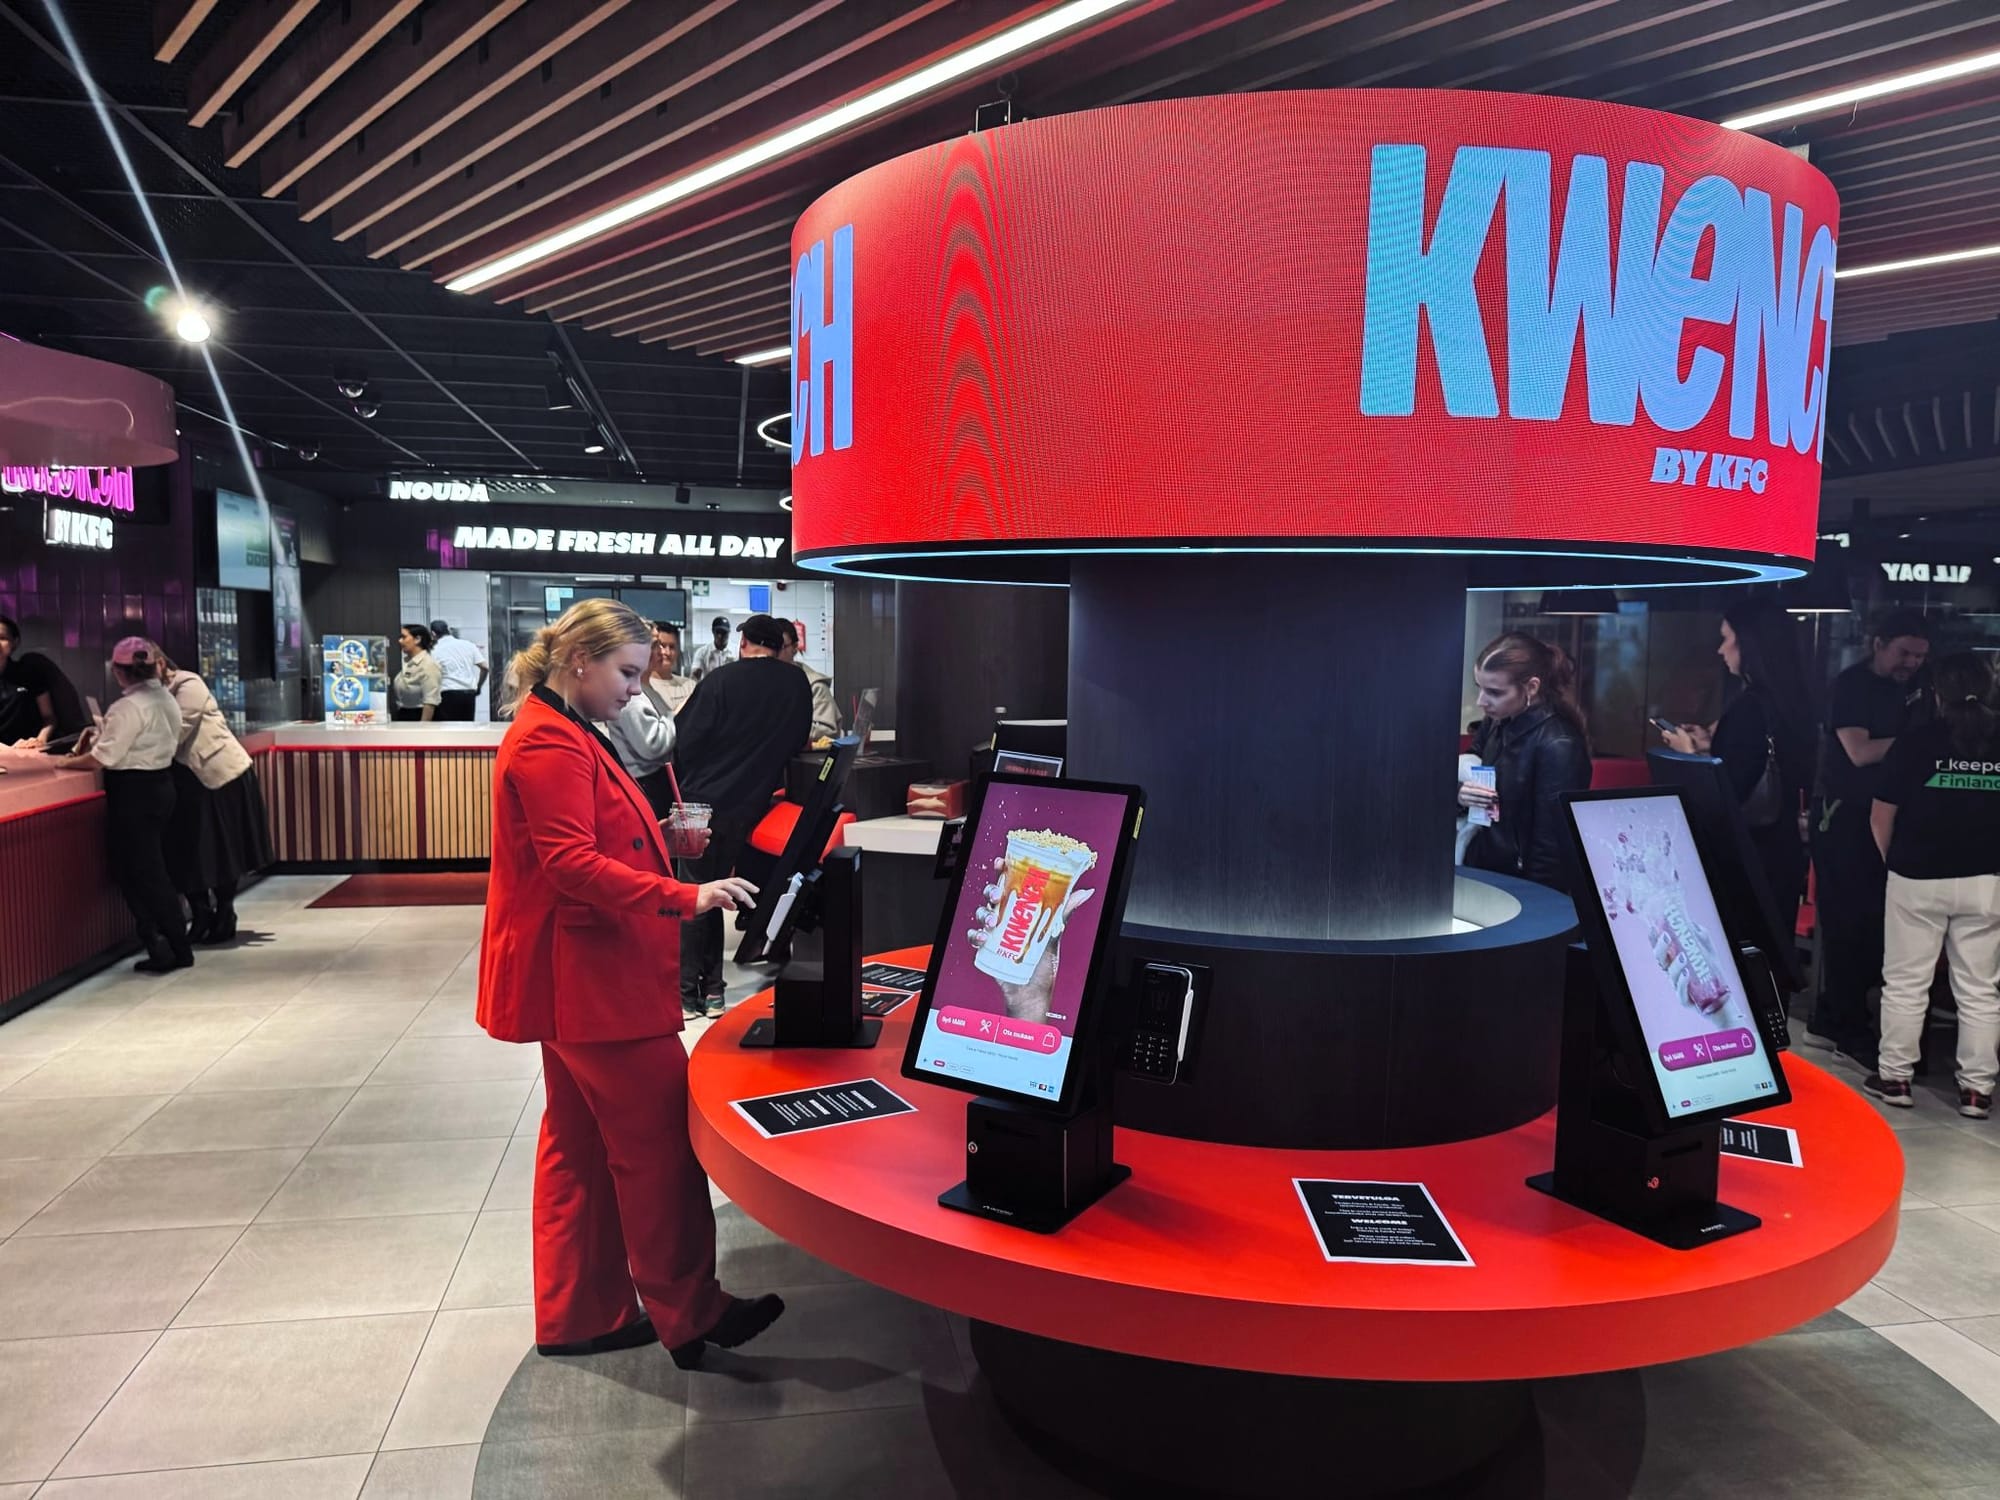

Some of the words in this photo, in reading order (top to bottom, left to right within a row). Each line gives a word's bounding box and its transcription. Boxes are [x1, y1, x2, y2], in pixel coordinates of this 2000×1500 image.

[791, 223, 853, 470] CH
[1650, 447, 1707, 486] BY
[1707, 452, 1768, 495] KFC
[389, 481, 490, 502] NOUDA
[71, 512, 113, 549] KFC
[454, 526, 555, 551] MADE
[557, 530, 656, 555] FRESH
[659, 533, 715, 557] ALL
[719, 535, 785, 558] DAY
[1351, 1218, 1408, 1226] WELCOME
